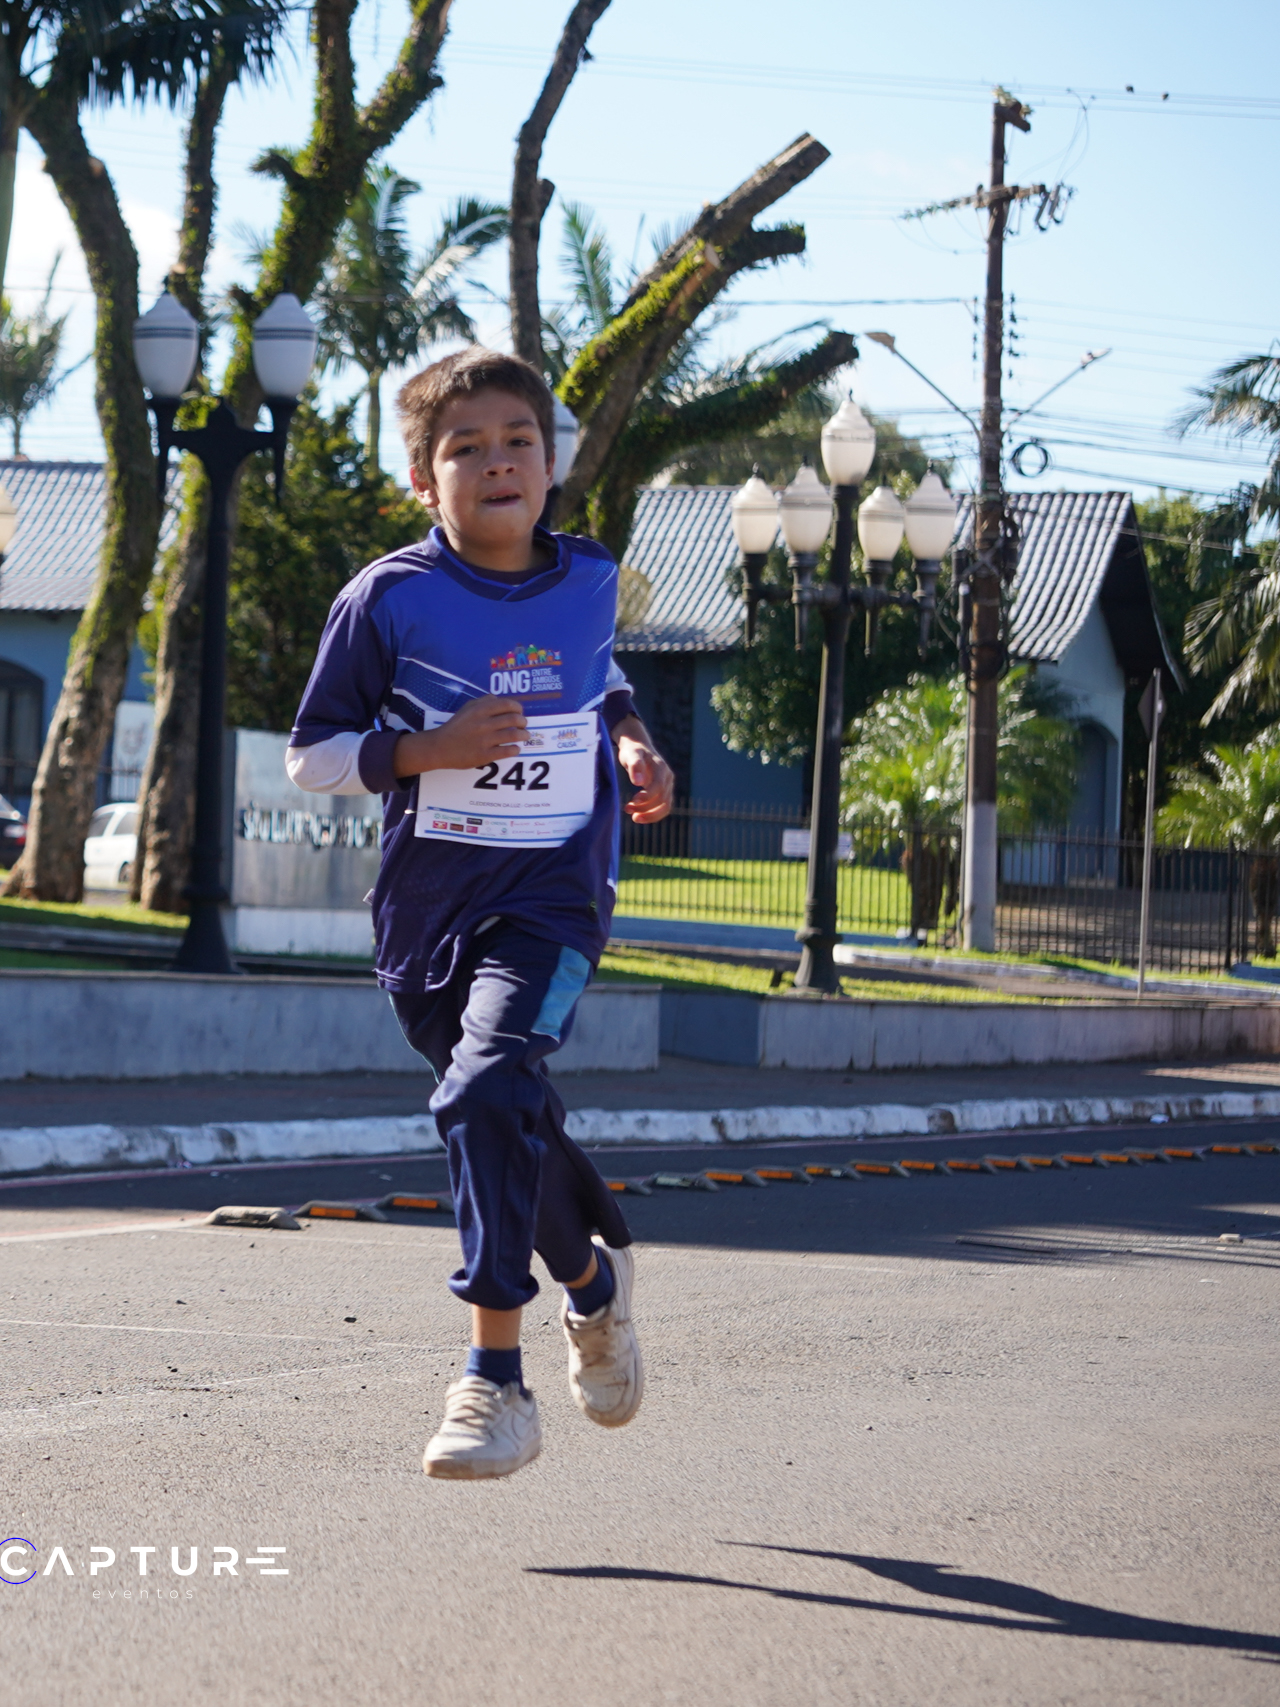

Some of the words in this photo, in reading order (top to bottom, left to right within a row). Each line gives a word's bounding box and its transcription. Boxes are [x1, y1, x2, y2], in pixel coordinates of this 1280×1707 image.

[490, 670, 530, 695] ONG
[532, 668, 552, 676] ENTRE
[473, 761, 550, 791] 242
